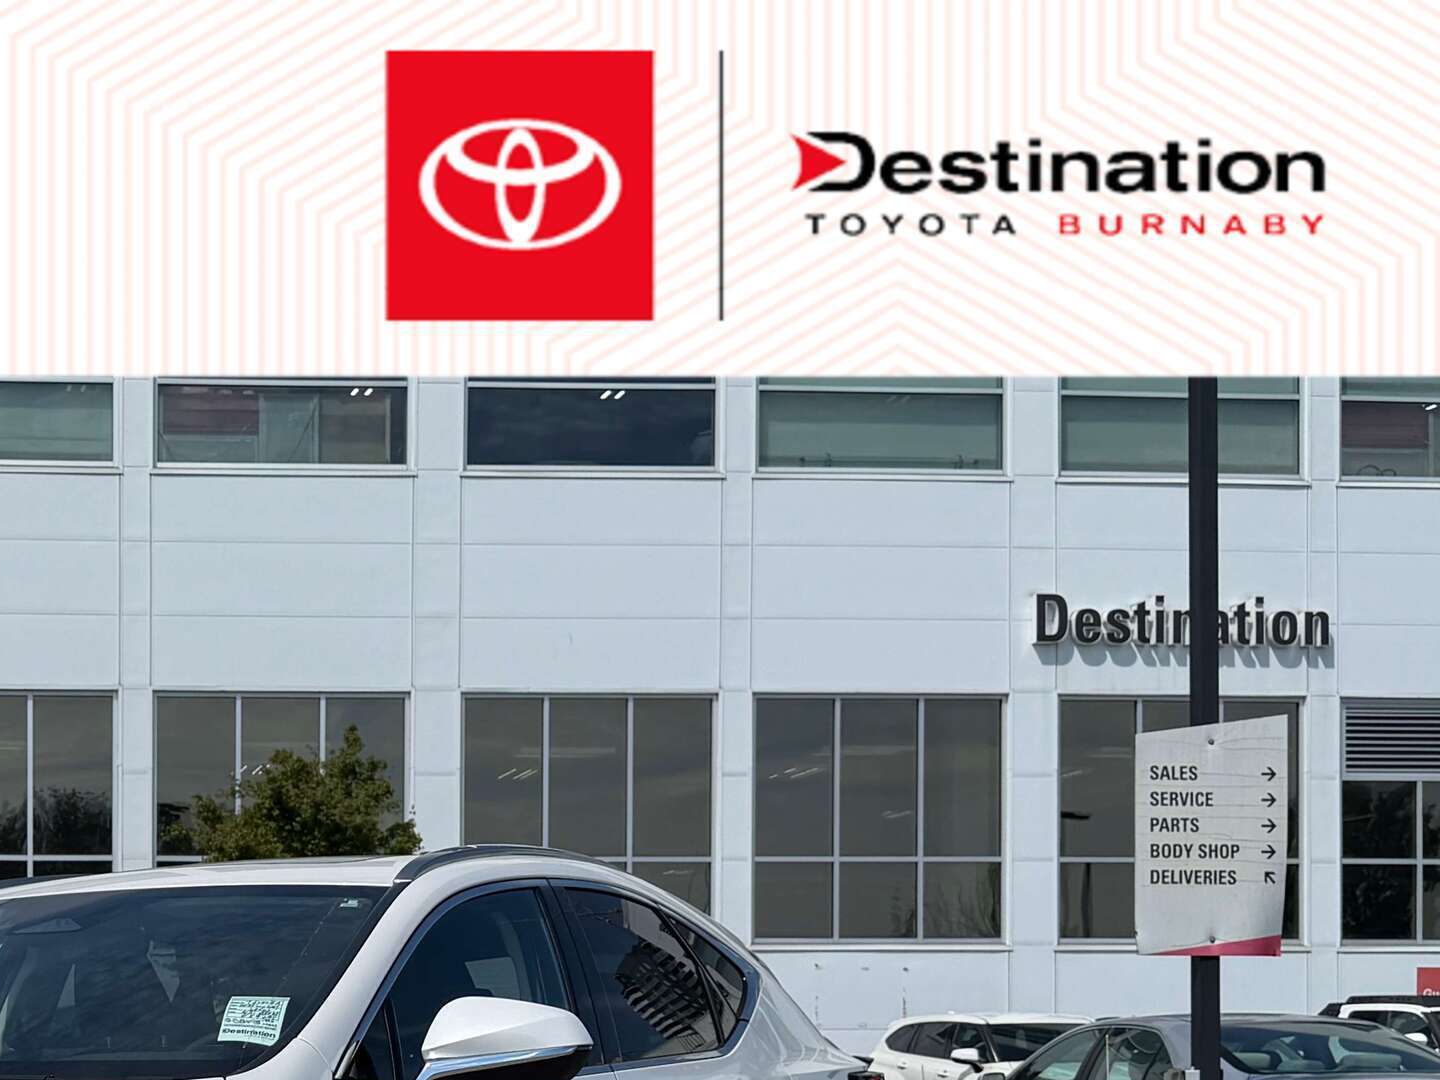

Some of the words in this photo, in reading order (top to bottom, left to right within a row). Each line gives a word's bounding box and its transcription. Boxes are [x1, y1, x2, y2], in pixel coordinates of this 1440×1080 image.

[1149, 765, 1198, 781] SALES
[1149, 791, 1214, 807] SERVICE
[1150, 817, 1200, 833] PARTS
[1150, 843, 1193, 859] BODY
[1198, 843, 1240, 860] SHOP
[1150, 869, 1237, 886] DELIVERIES
